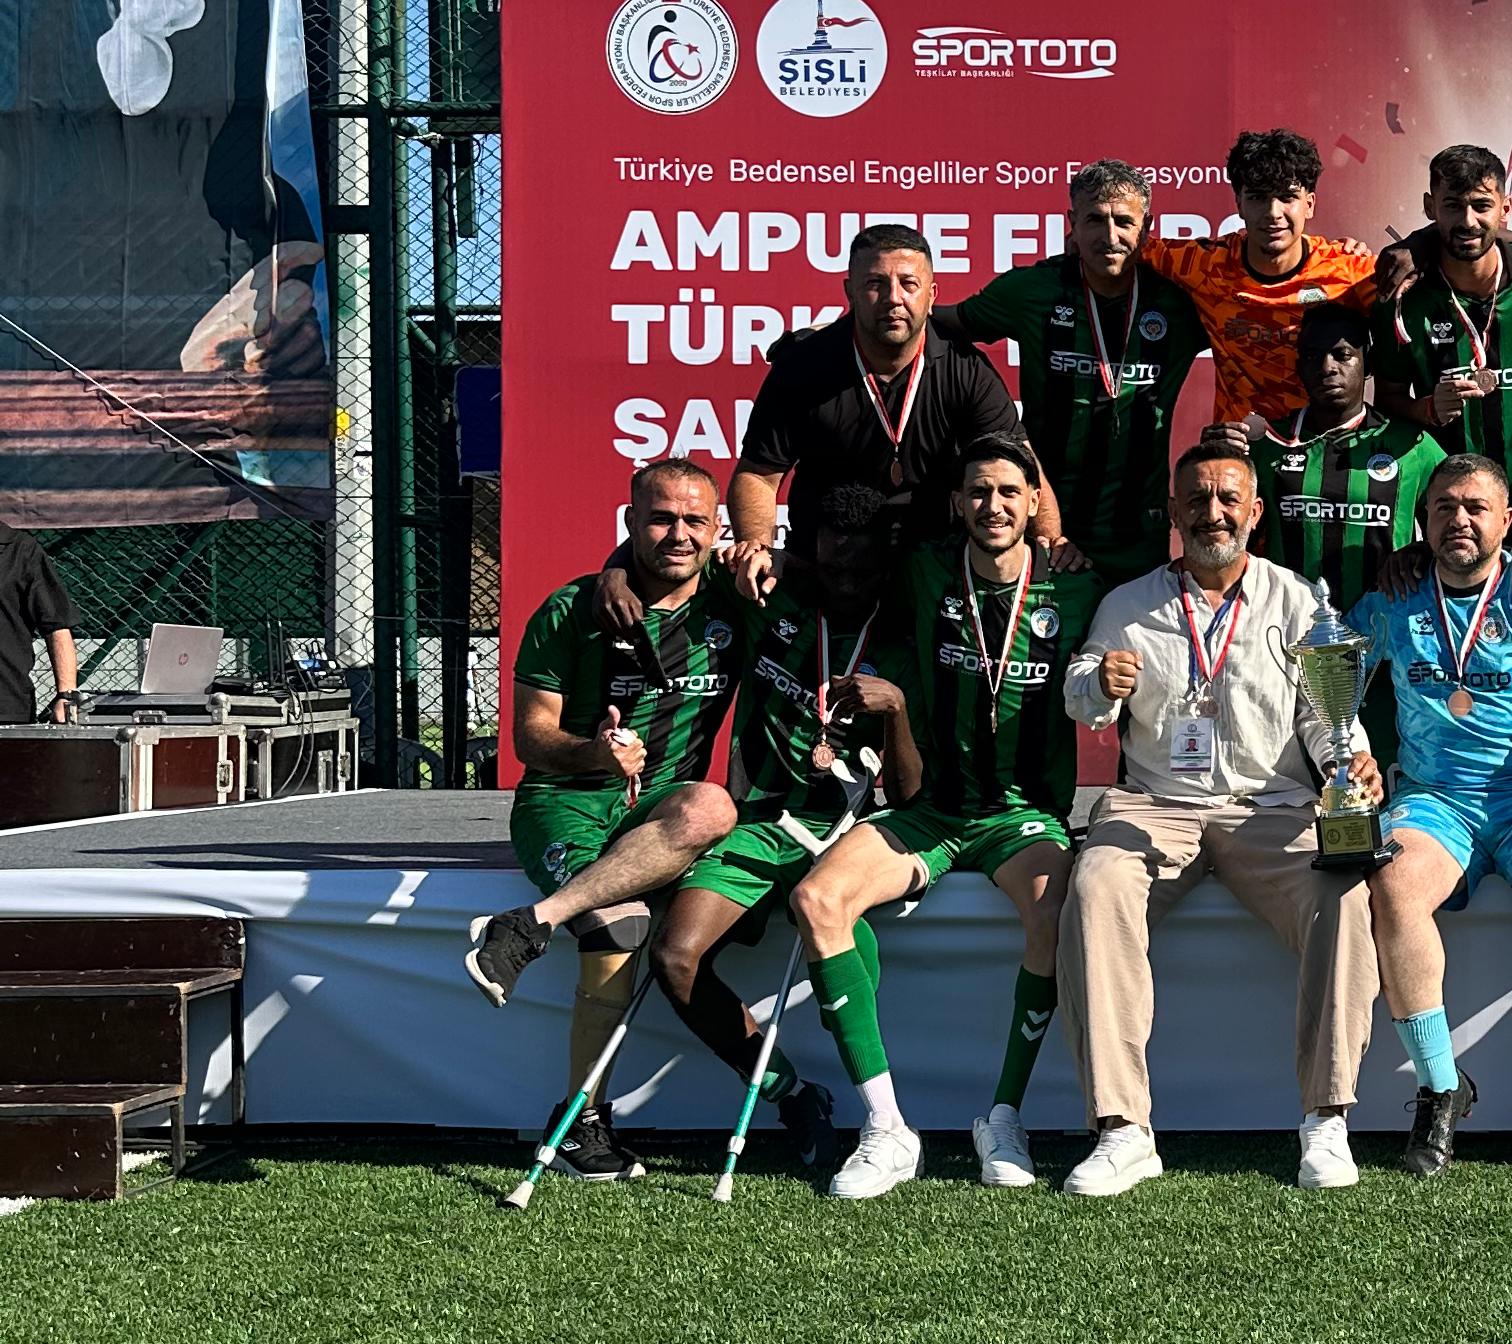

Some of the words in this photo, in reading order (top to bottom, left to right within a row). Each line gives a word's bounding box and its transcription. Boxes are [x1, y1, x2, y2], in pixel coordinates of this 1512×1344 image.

[912, 39, 1117, 67] SPORTOTO
[648, 94, 674, 107] SPOR
[613, 157, 714, 187] Türkiye
[730, 159, 855, 183] Bedensel
[864, 160, 989, 190] Engelliler
[995, 161, 1059, 189] Spor
[609, 210, 970, 273] AMPUE
[1280, 502, 1391, 521] SPORTOTO
